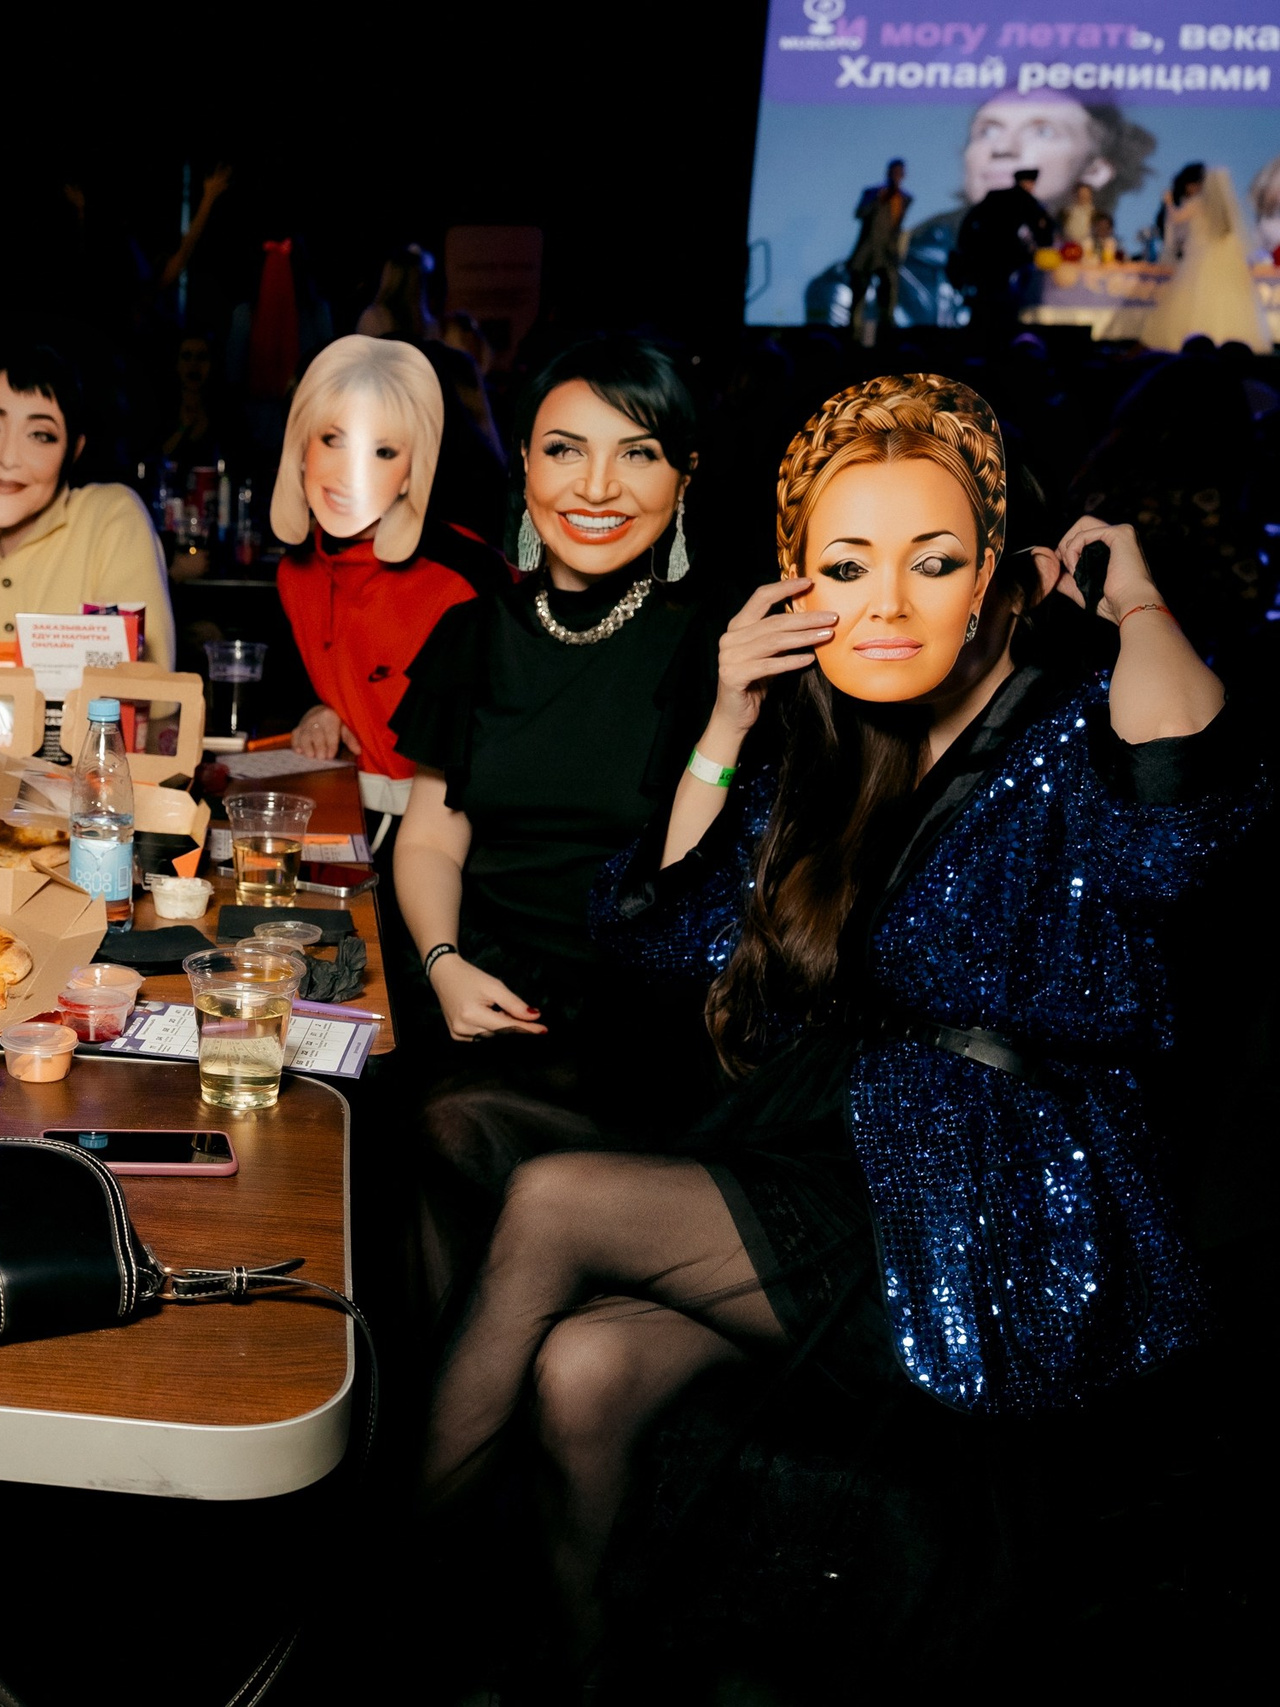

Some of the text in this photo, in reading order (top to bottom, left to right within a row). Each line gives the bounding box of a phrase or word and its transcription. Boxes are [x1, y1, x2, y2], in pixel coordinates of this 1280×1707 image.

[880, 22, 987, 55] могу
[996, 22, 1165, 55] летать,
[835, 54, 1270, 95] Хлопай ресницами
[33, 624, 107, 632] ЗАКАЗЫВАЙТЕ
[31, 641, 74, 649] ОНЛАЙН
